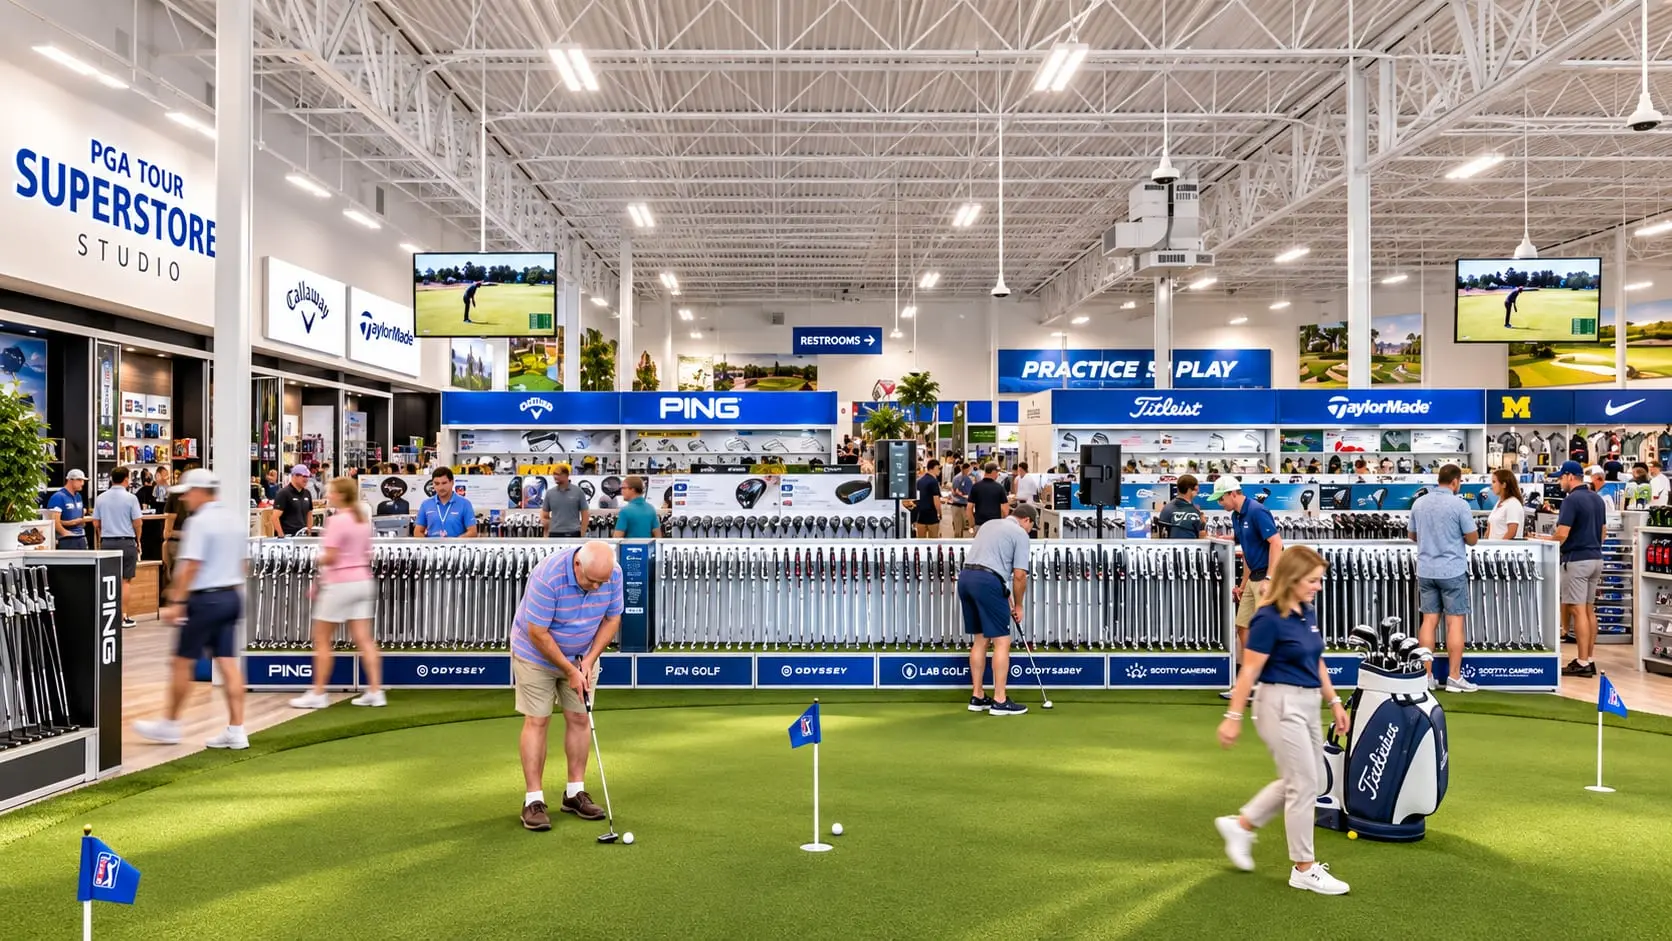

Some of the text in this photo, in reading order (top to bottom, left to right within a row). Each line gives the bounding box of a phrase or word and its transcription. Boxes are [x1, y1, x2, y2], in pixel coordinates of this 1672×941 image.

[90, 138, 184, 199] PGA TOUR
[15, 148, 216, 258] SUPERSTORE
[77, 233, 181, 282] STUDIO
[286, 281, 329, 319] Callaway
[360, 310, 414, 346] TaylorMade
[800, 335, 861, 346] RESTROOMS
[1021, 360, 1140, 378] PRACTICE
[1175, 360, 1238, 378] PLAY
[659, 397, 740, 419] PING
[1129, 396, 1203, 418] Titleist
[1327, 395, 1430, 419] TaylorMade
[1501, 396, 1532, 418] M
[102, 575, 117, 665] PING
[268, 664, 313, 677] PING
[431, 666, 486, 674] ODYSSEY
[691, 666, 721, 676] GOLF
[795, 667, 848, 675] ODYSSEY
[920, 667, 970, 676] LAB GOLF
[1150, 667, 1217, 675] SCOTTY CAMERON
